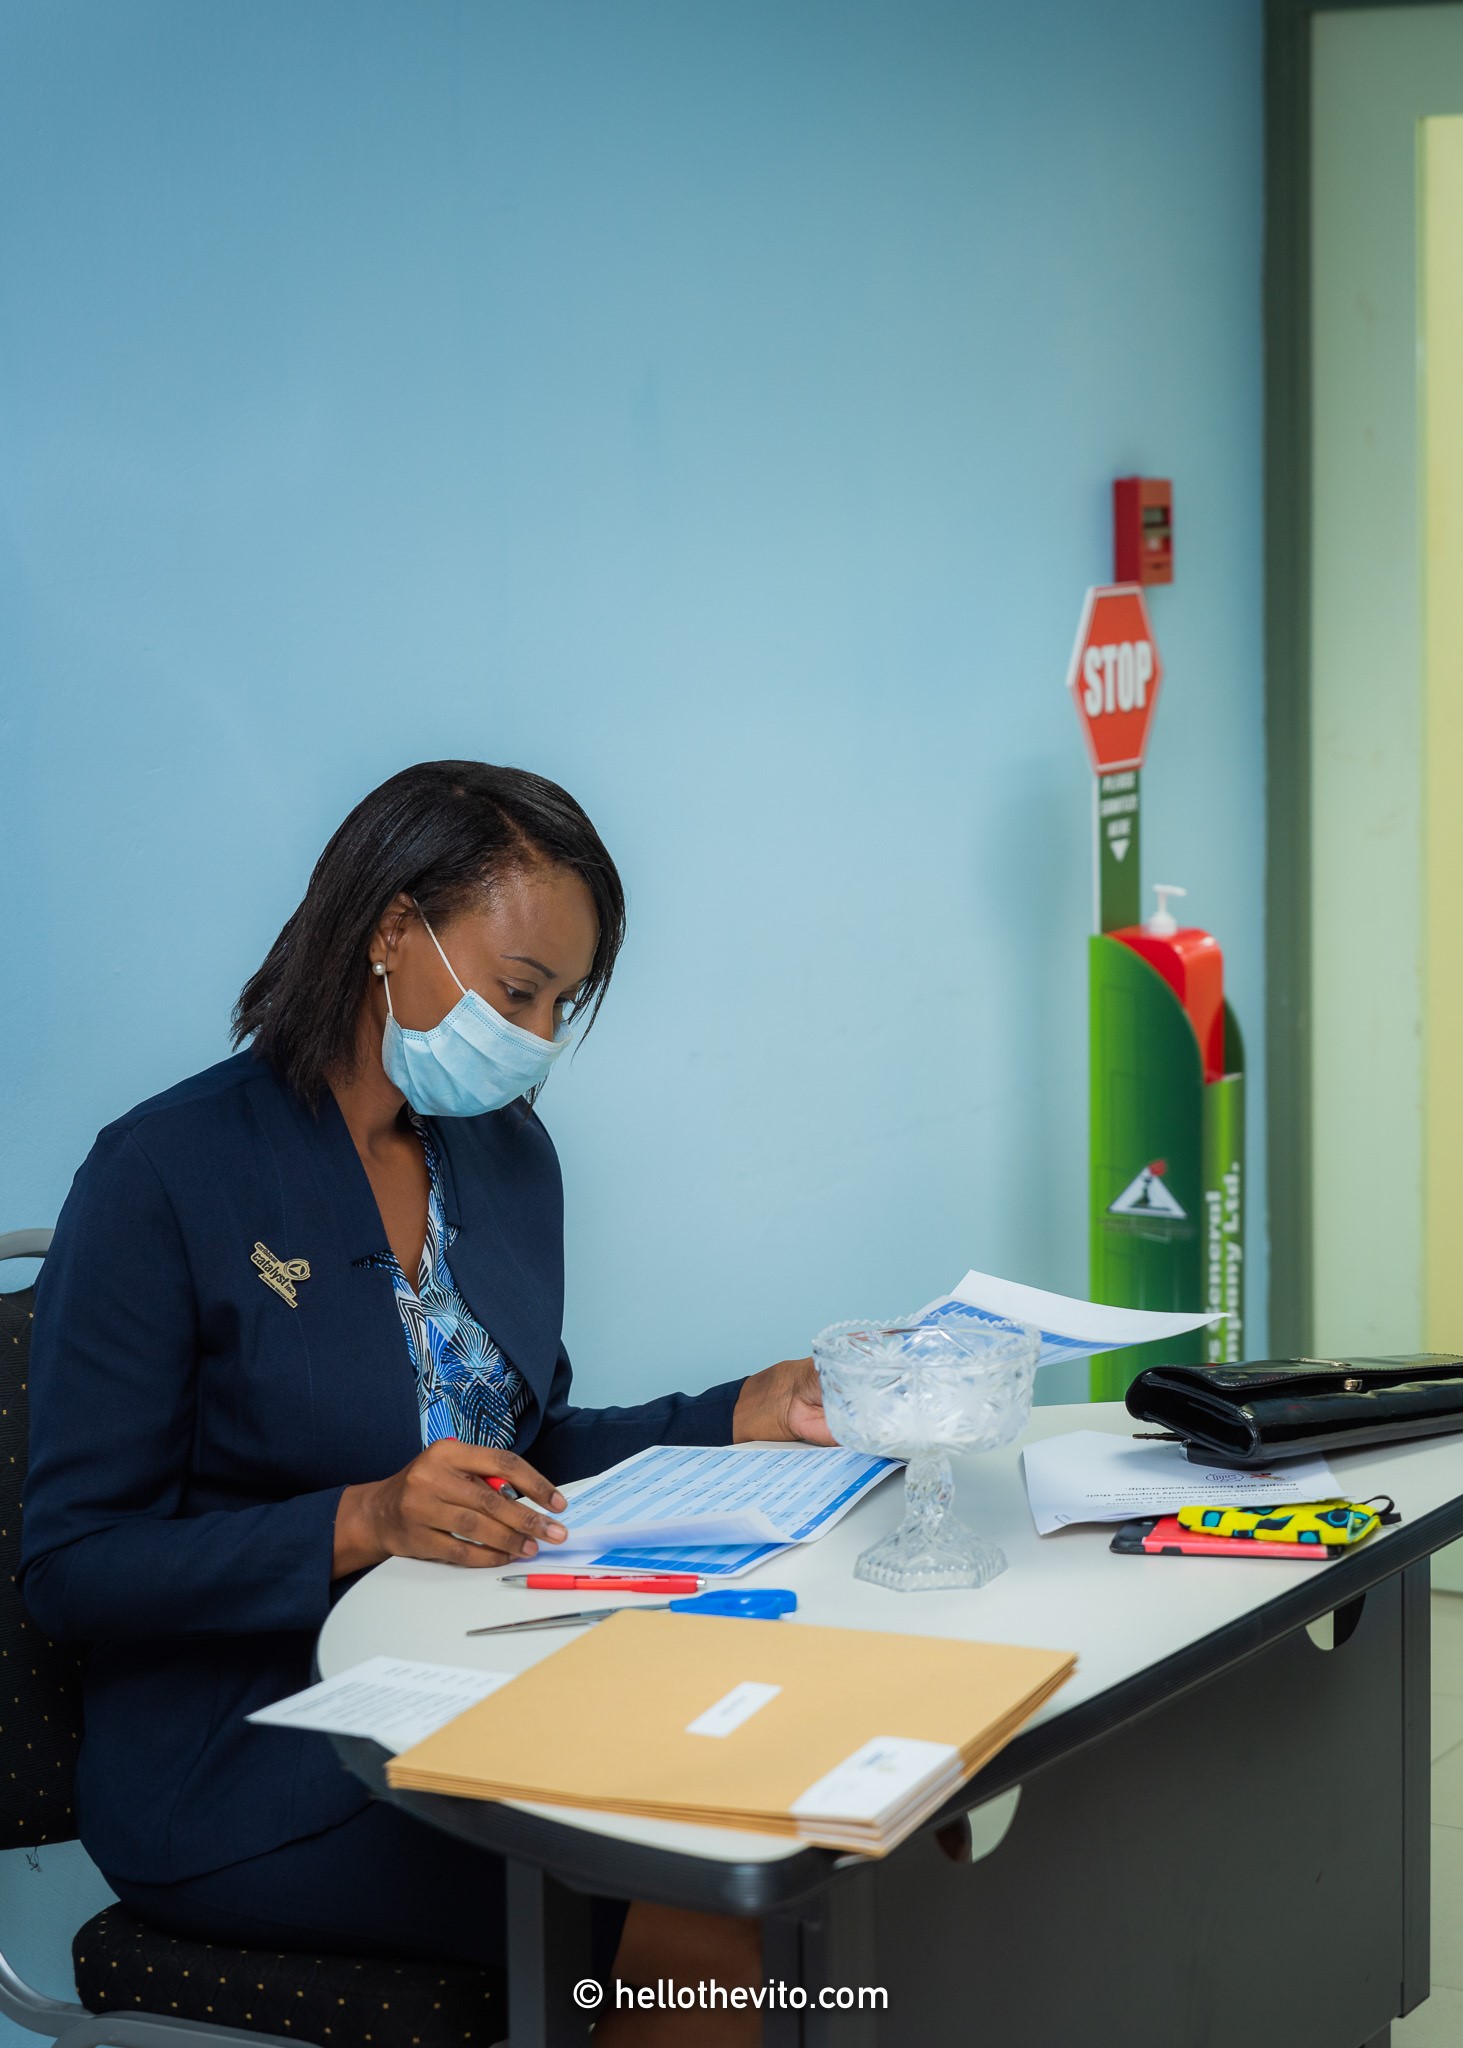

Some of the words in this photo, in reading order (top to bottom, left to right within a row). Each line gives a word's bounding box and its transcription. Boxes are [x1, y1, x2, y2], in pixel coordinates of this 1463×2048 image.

[1084, 641, 1153, 717] STOP
[1223, 1162, 1239, 1233] Ltd.
[252, 1253, 290, 1287] catalyst
[1226, 1241, 1243, 1362] mpany
